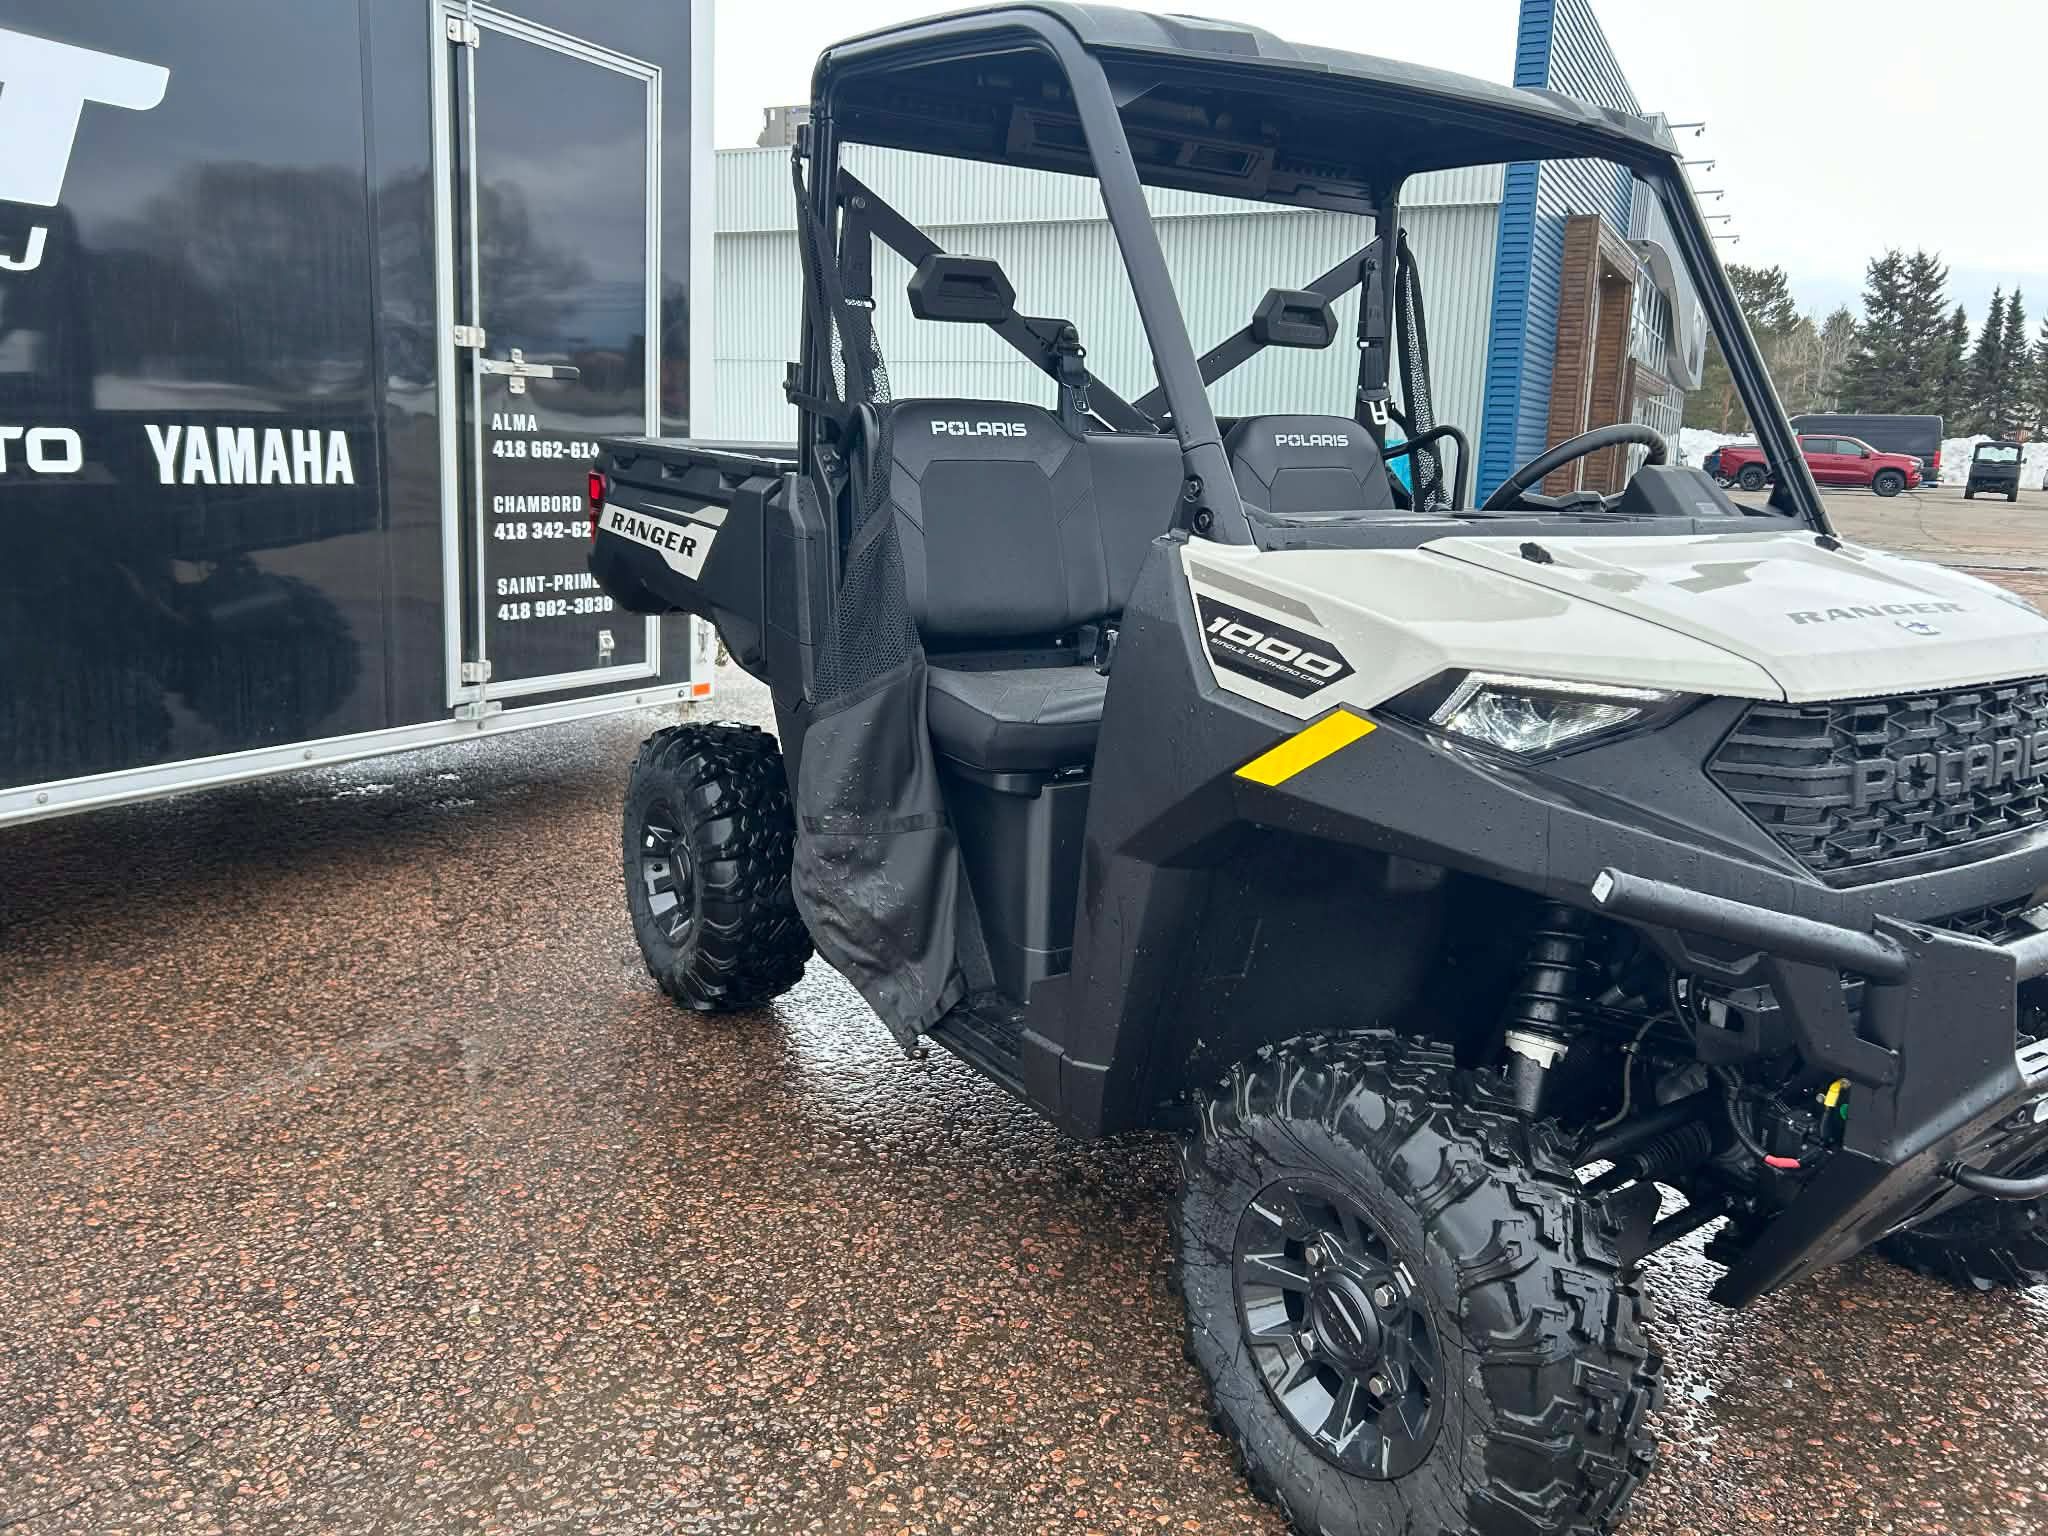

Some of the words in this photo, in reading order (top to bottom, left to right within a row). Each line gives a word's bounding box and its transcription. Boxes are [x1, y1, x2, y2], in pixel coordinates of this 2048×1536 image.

[491, 413, 538, 432] ALMA
[930, 420, 1027, 438] POLARIS
[492, 439, 526, 458] 418
[1275, 434, 1349, 447] POLARIS
[144, 424, 356, 485] YAMAHA
[493, 495, 582, 514] CHAMBORD
[494, 521, 527, 540] 418
[610, 511, 697, 558] RANGER
[497, 602, 531, 621] 418
[535, 595, 613, 617] 902-3030
[1785, 601, 1967, 625] RANGER
[1206, 616, 1343, 678] 1000
[1209, 637, 1246, 655] SINGLE
[1246, 652, 1300, 677] OVERHEAD
[1300, 673, 1326, 686] CAM
[1852, 730, 2048, 808] POLARIS
